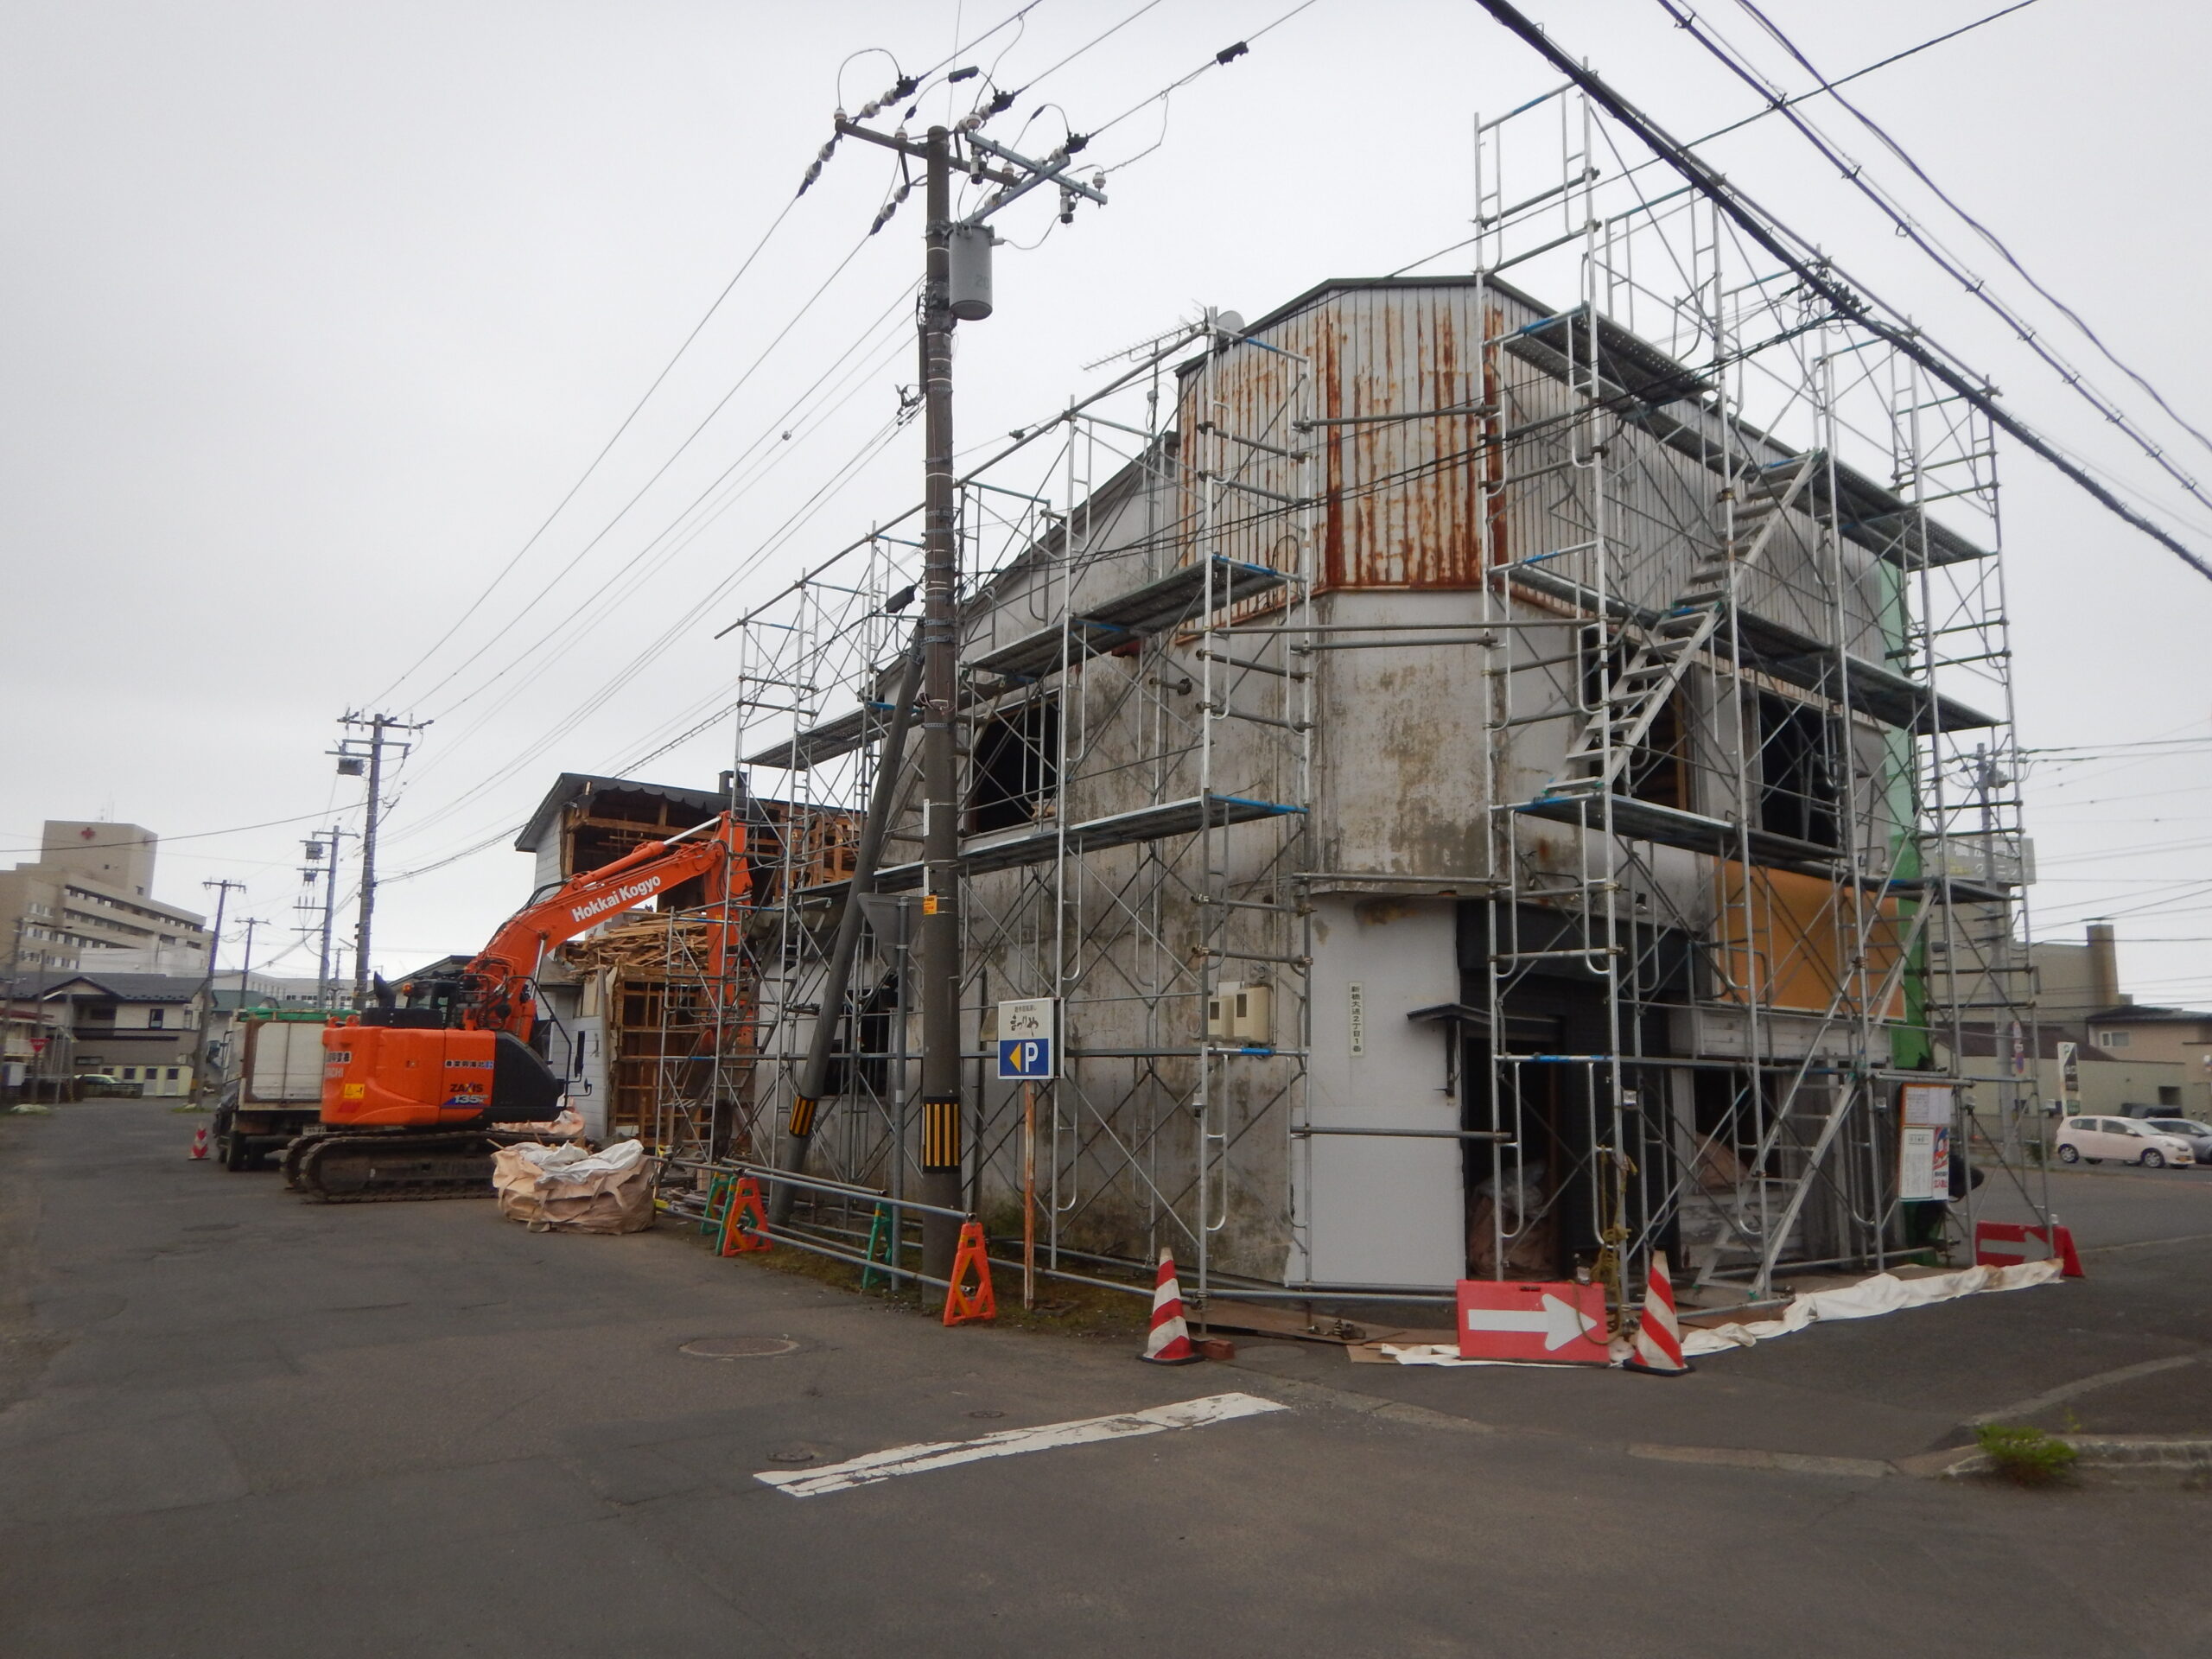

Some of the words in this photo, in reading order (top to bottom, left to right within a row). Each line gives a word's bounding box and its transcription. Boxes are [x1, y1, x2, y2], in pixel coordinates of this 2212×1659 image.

[572, 891, 620, 922] Hokkai
[619, 875, 661, 901] Kogyo
[1010, 1014, 1039, 1038] まつりや
[1025, 1041, 1039, 1073] P
[449, 1082, 484, 1092] ZAXIS
